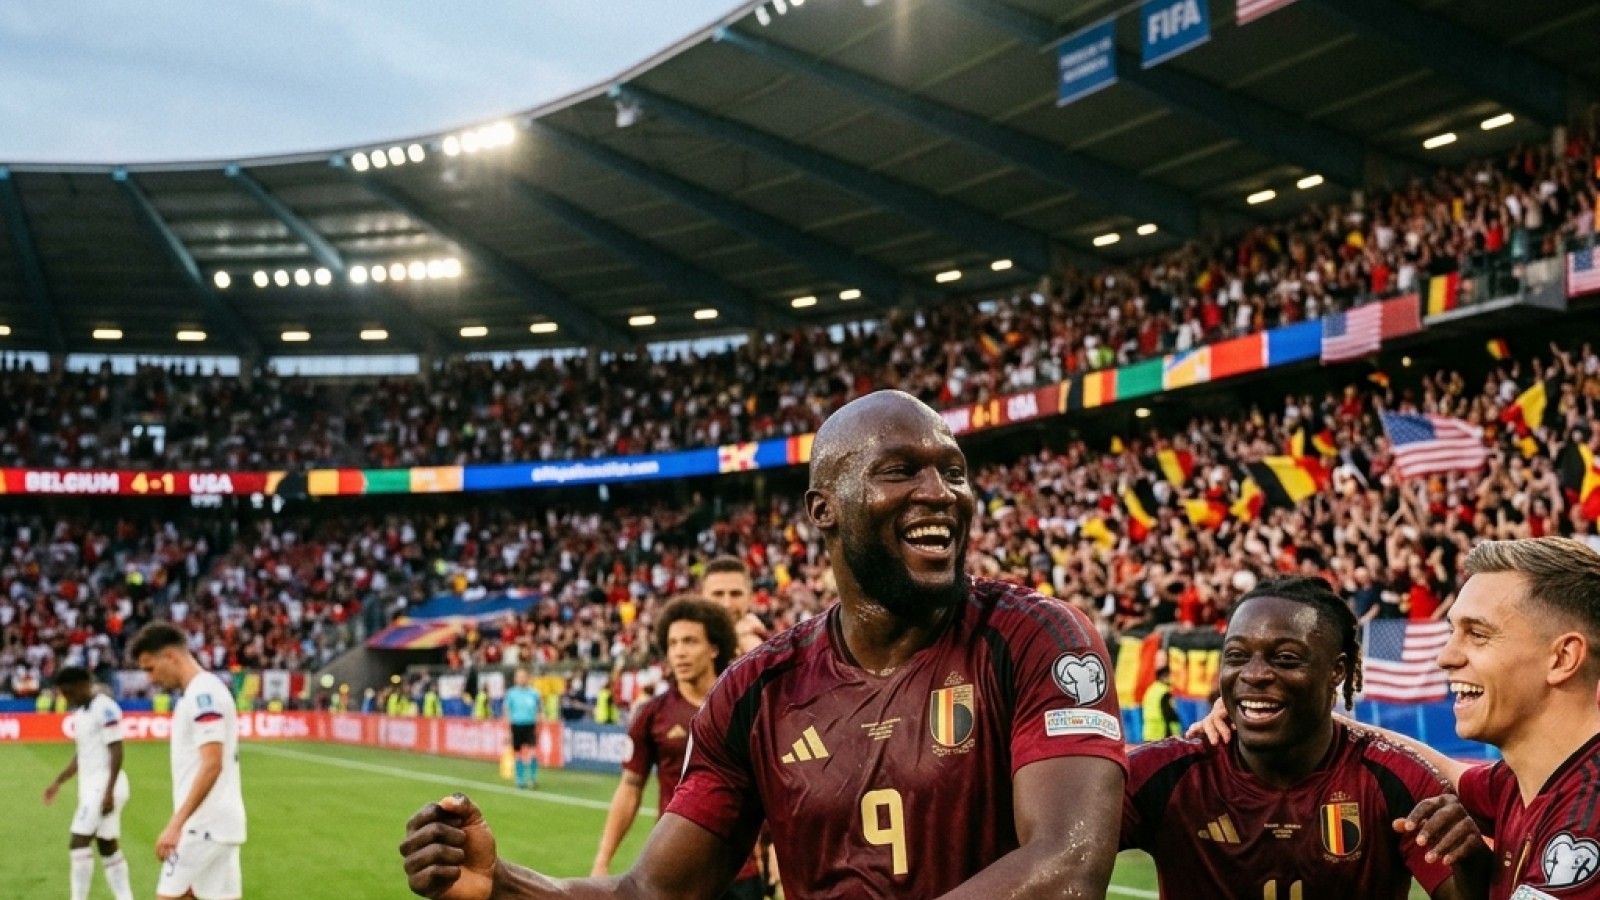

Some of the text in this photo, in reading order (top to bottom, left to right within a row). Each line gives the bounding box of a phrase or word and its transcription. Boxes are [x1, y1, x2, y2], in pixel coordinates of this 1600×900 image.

[1147, 0, 1202, 45] FIFA
[24, 471, 234, 495] BELGIUM 4-1 USA
[861, 788, 909, 875] 9
